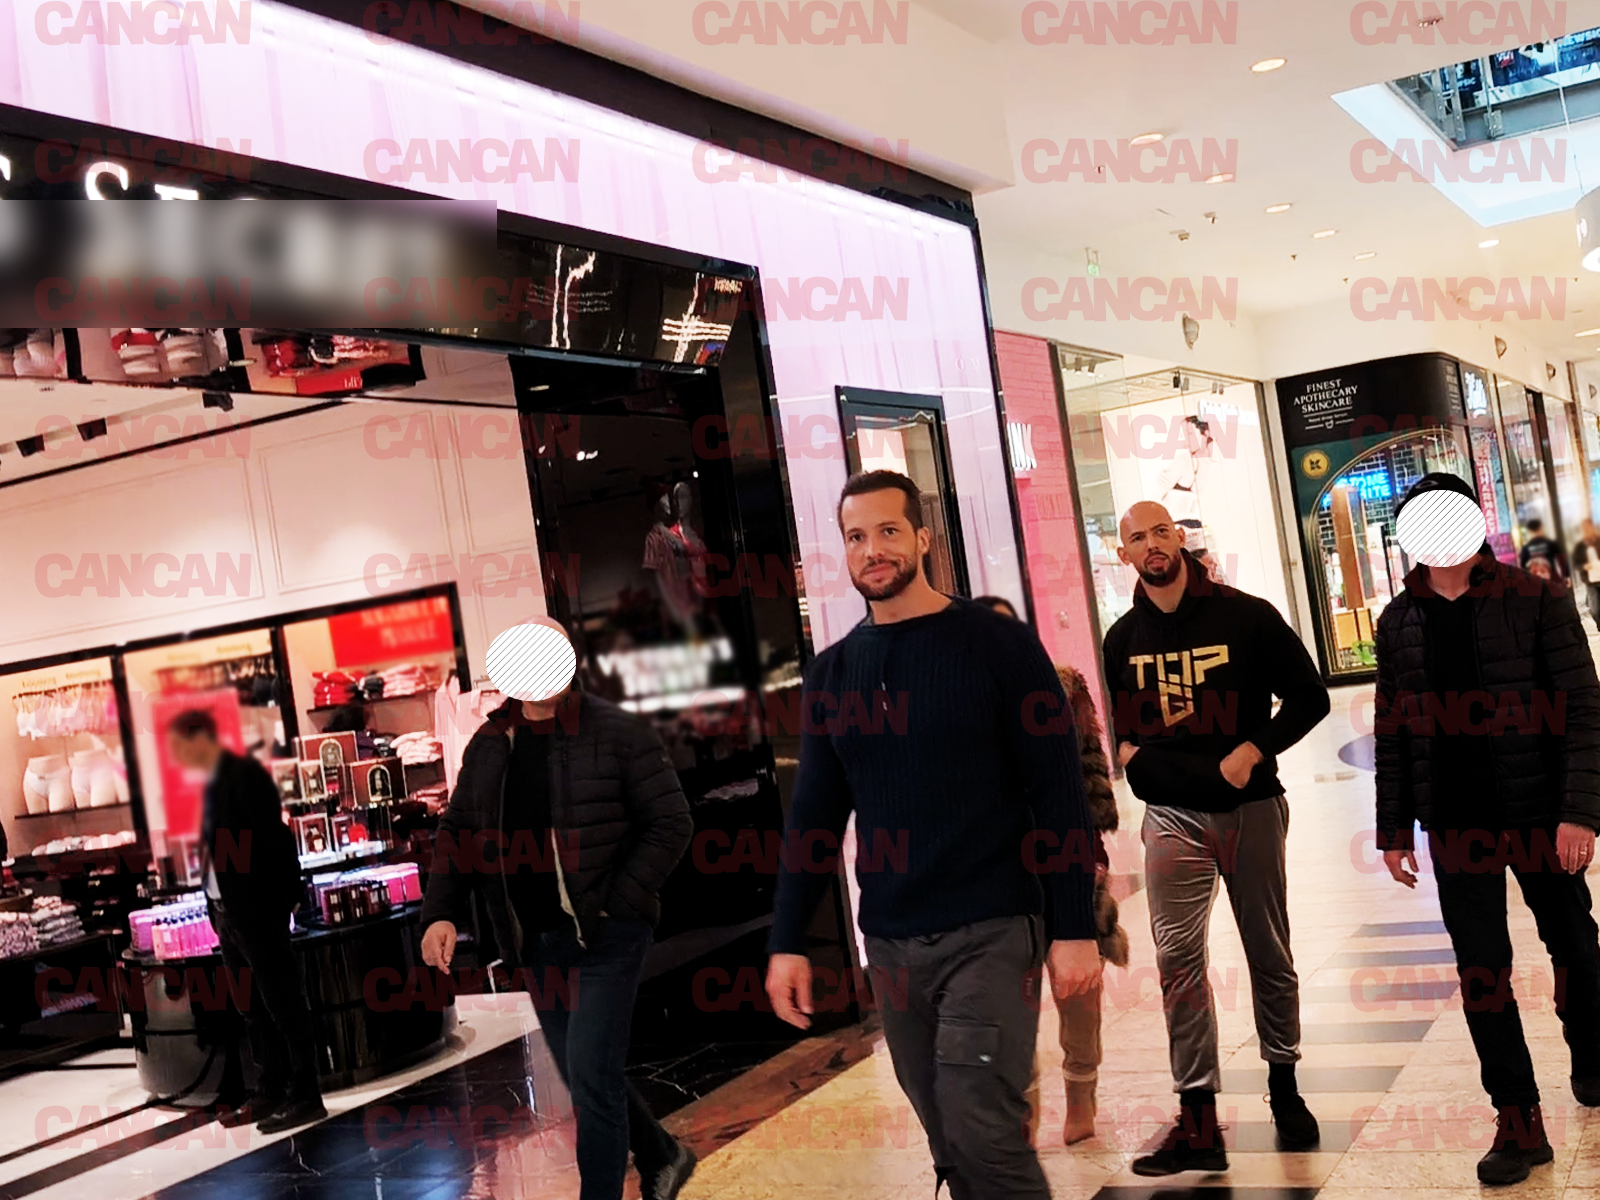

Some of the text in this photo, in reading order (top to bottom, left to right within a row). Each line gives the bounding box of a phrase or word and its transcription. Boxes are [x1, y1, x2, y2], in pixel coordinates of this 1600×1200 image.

[1294, 385, 1358, 406] APOTHECARY
[1306, 379, 1341, 393] FINEST
[1301, 396, 1353, 414] SKINCARE
[1128, 644, 1230, 690] TOP
